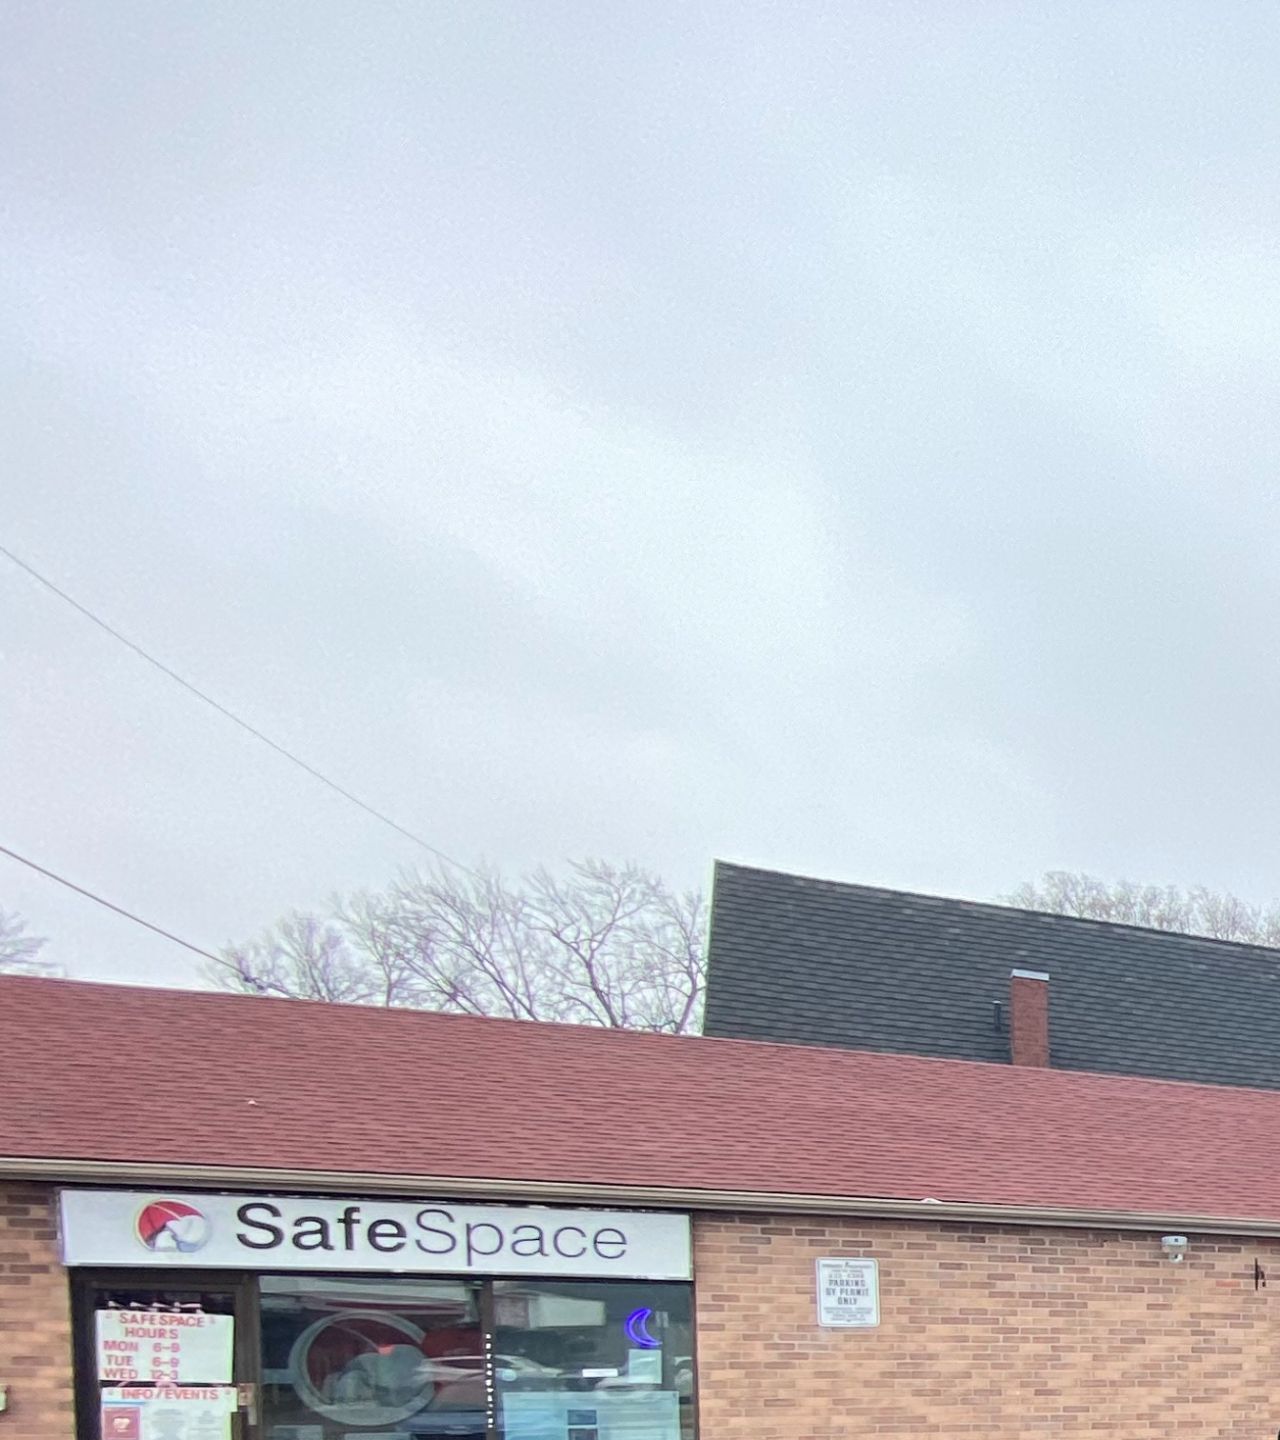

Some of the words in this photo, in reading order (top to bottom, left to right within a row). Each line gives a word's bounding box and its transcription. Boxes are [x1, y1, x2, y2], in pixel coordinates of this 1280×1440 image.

[236, 1202, 628, 1267] SafeSpace
[124, 1327, 179, 1340] HOURS
[103, 1340, 139, 1352] MON
[106, 1355, 134, 1366] TUE
[103, 1368, 139, 1380] WED
